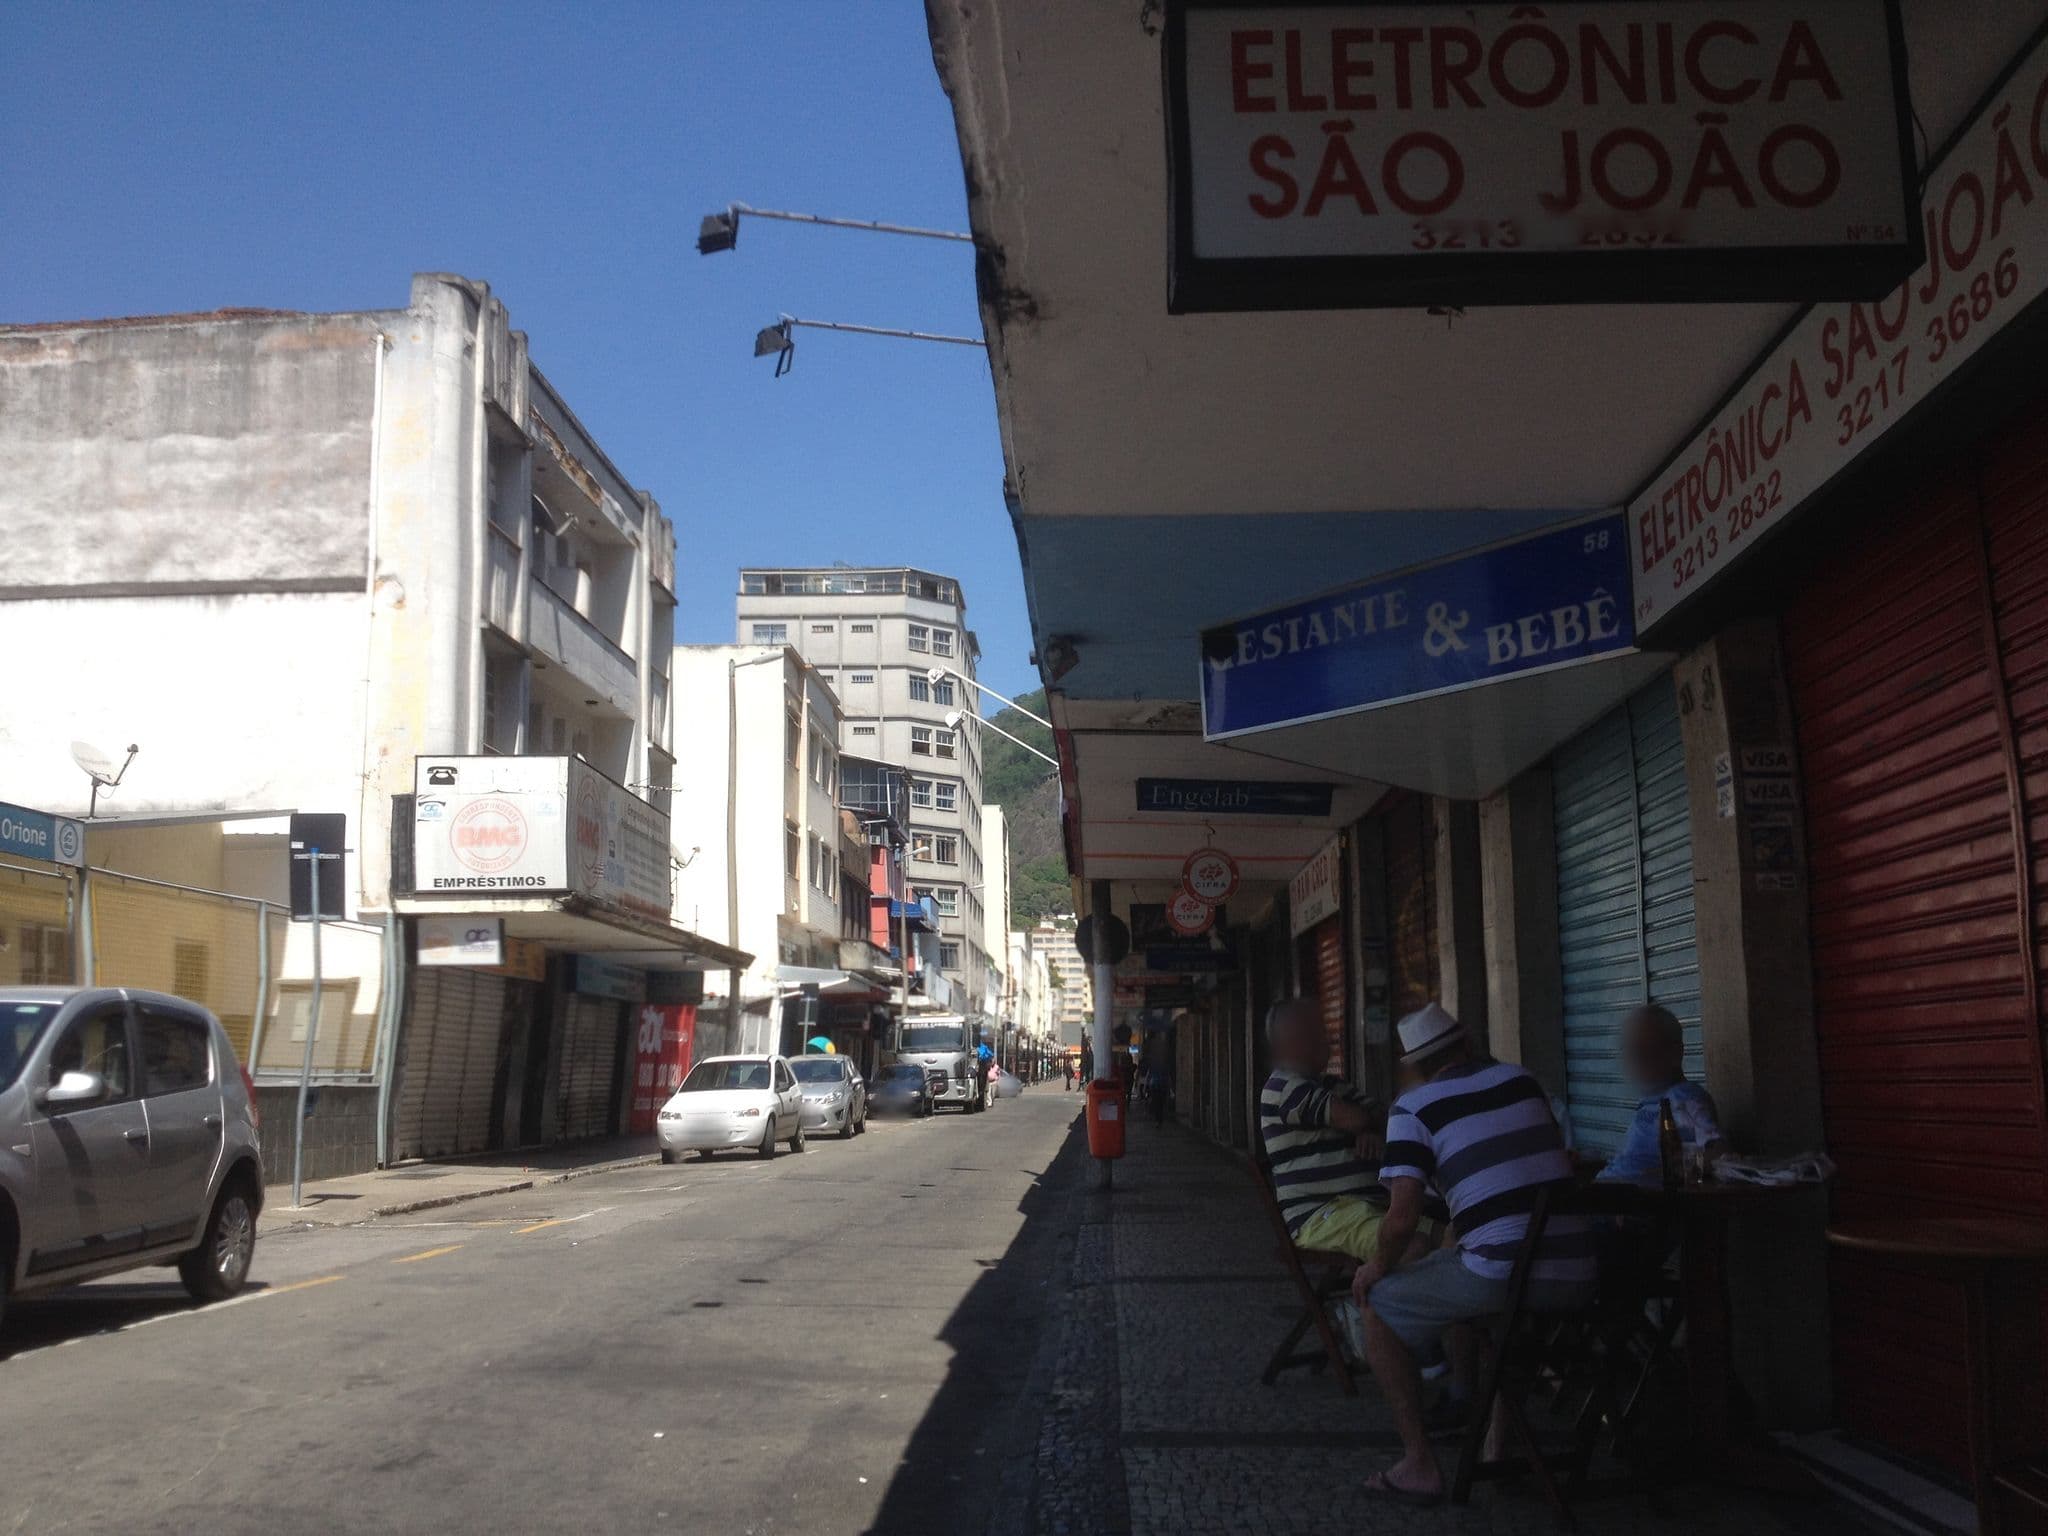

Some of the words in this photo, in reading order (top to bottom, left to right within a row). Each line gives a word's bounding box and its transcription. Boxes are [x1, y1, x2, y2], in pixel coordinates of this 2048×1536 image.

[1231, 6, 1844, 113] ELETRÔNICA
[1248, 118, 1464, 219] SÃO
[1536, 111, 1842, 213] JOÃO
[1672, 532, 1719, 590] 3213
[1727, 469, 1783, 546] 2832
[1838, 345, 1910, 447] 3217
[1927, 246, 2018, 363] 3686
[1640, 357, 1813, 575] ELETRÔNICA
[1423, 601, 1470, 658] &
[1485, 587, 1622, 667] BEBÊ
[1745, 752, 1788, 768] VISA
[1750, 784, 1793, 800] VISA
[1, 816, 47, 847] Orione
[433, 875, 547, 888] EMPRÉSTIMOS
